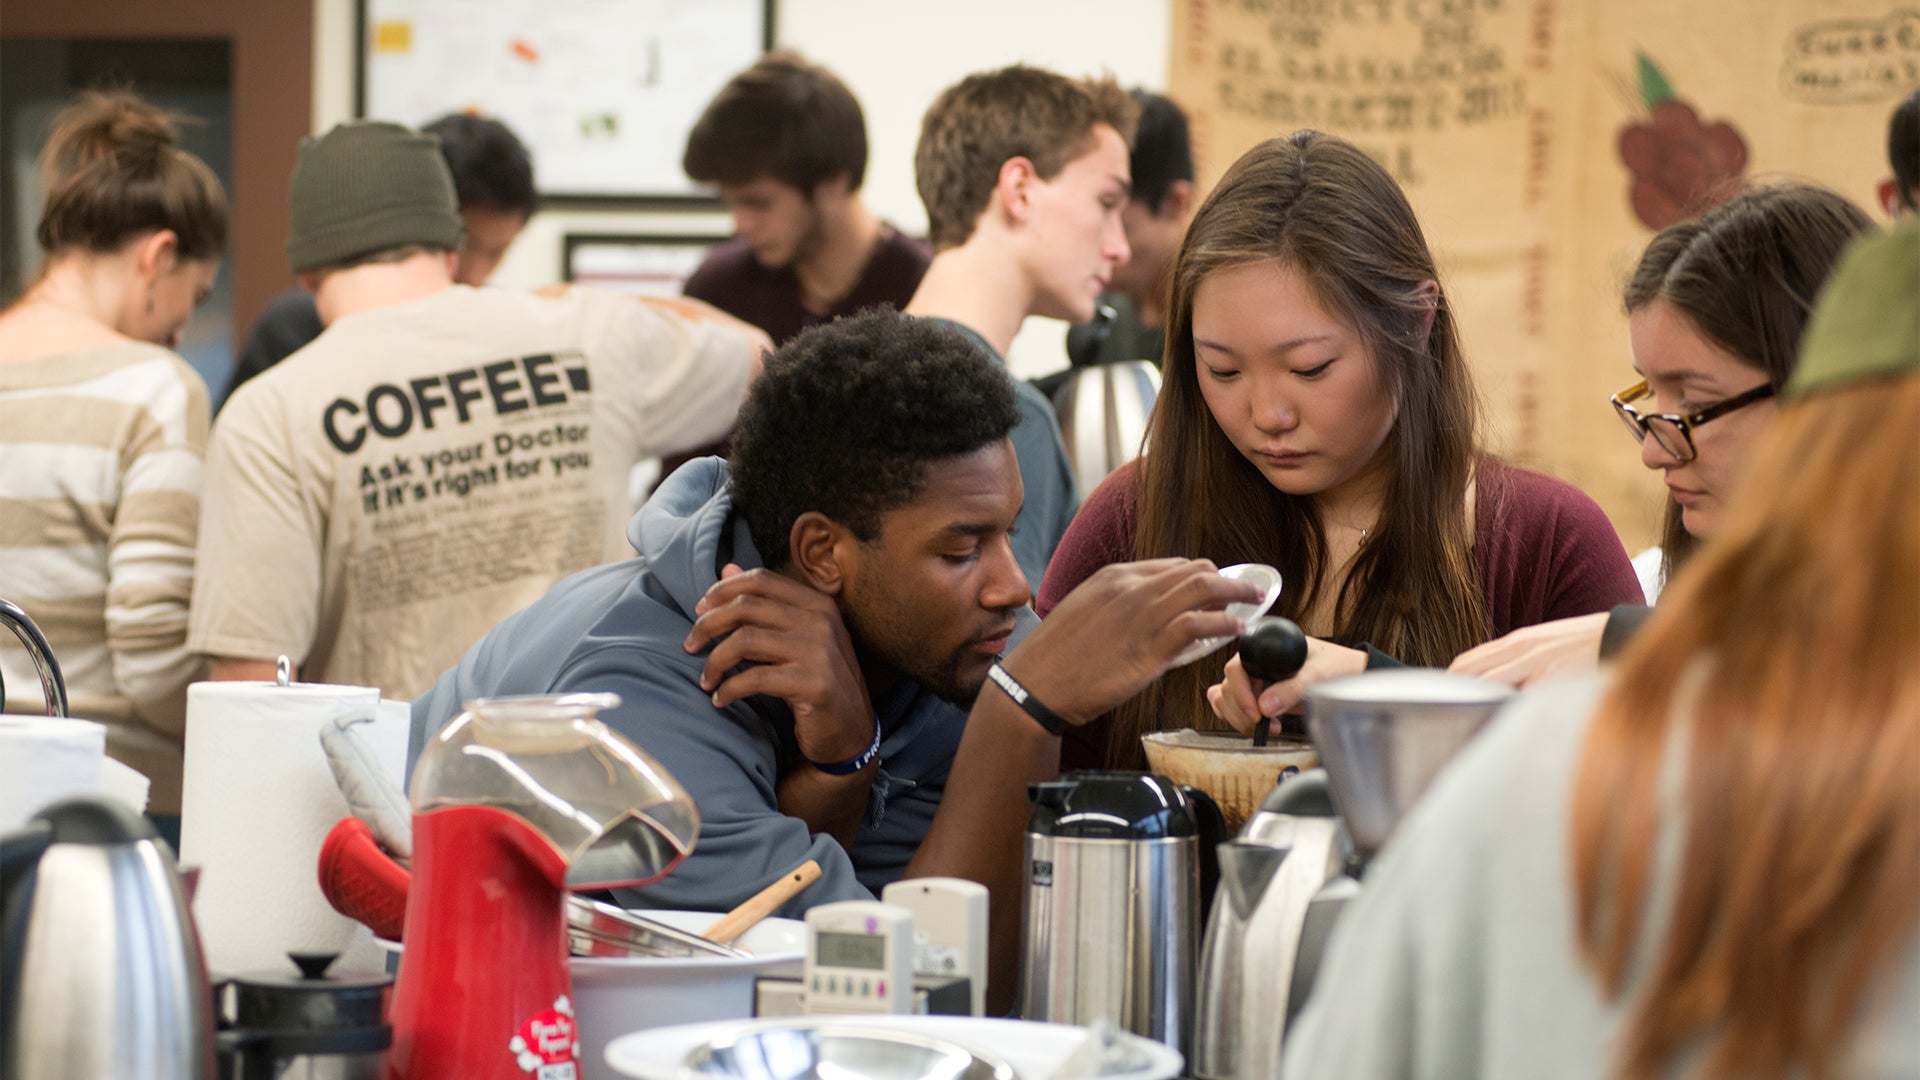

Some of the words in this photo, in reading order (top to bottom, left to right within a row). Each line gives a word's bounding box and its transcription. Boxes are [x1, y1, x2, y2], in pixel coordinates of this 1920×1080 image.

[323, 354, 568, 455] COFFEE
[360, 456, 412, 489] Ask
[422, 442, 484, 475] your
[492, 424, 590, 456] Doctor
[433, 464, 499, 496] right
[503, 456, 542, 480] for
[550, 451, 591, 477] you
